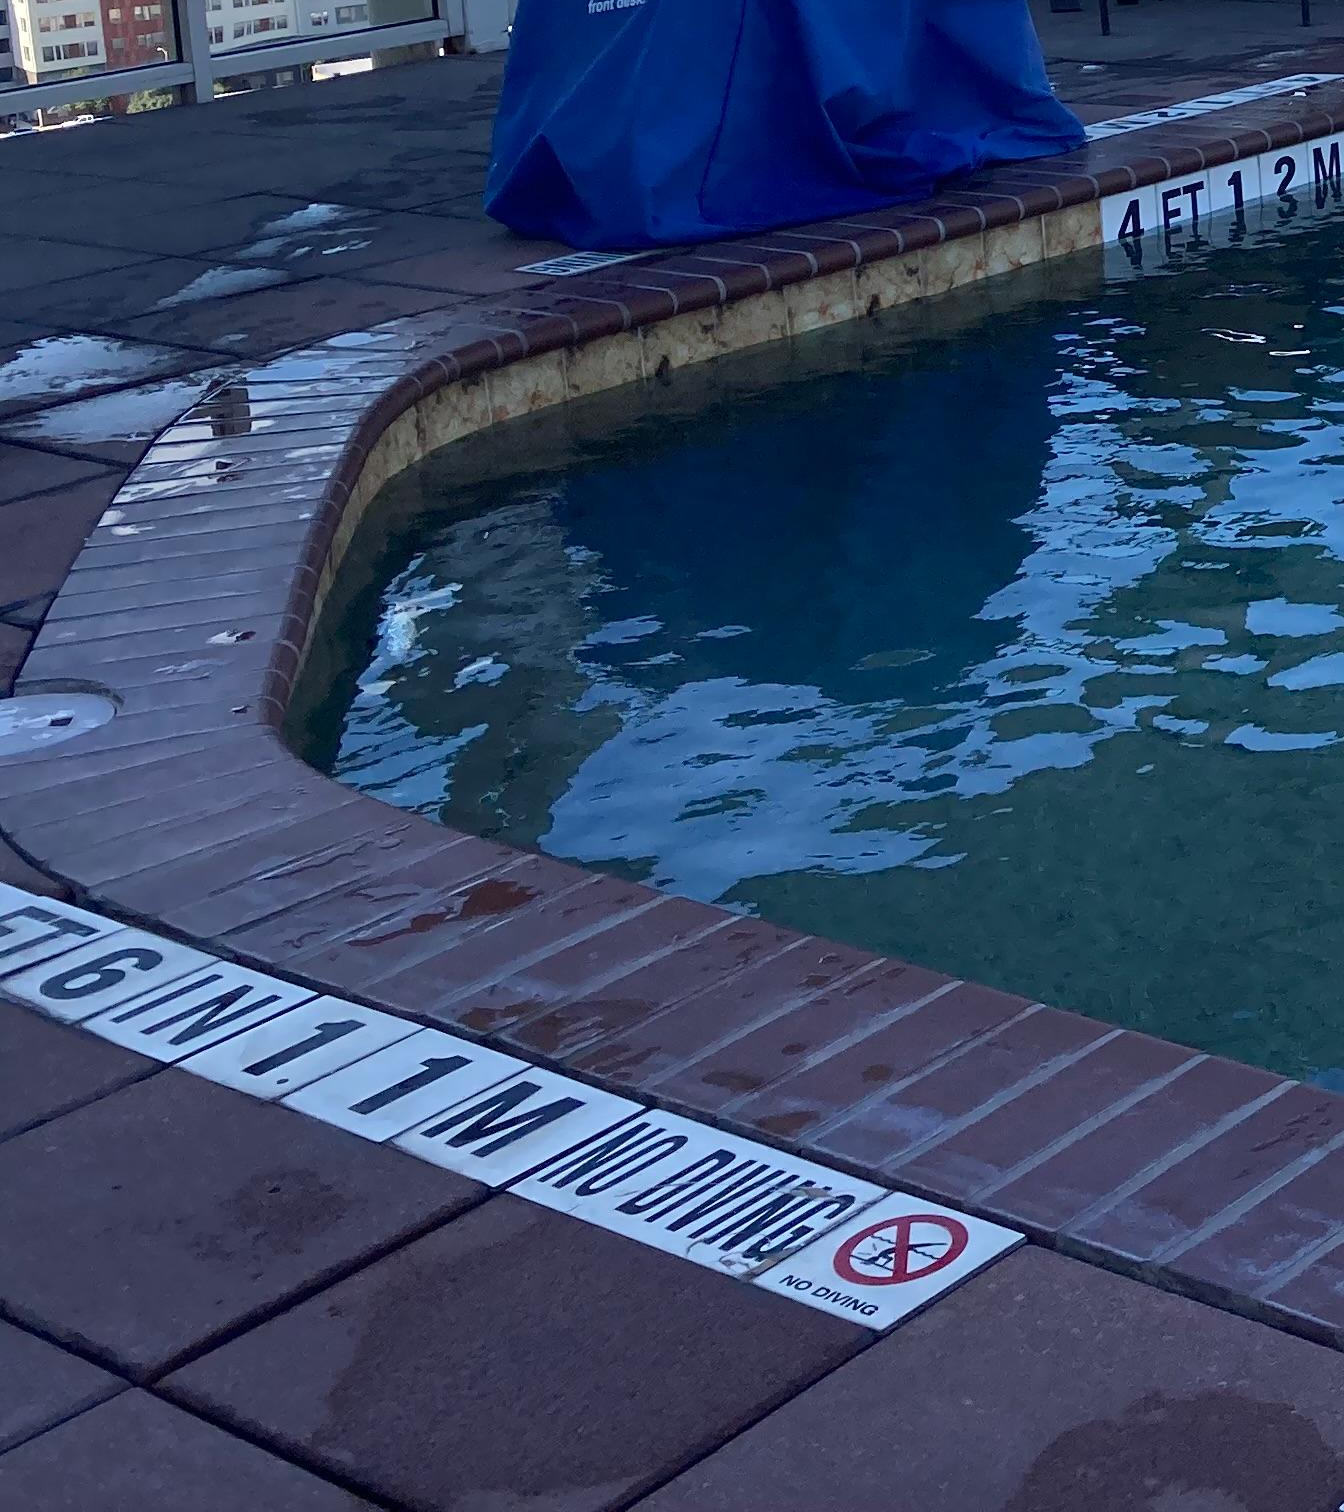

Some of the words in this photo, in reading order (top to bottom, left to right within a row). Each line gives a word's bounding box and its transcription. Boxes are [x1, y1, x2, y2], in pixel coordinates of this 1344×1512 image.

[1117, 199, 1145, 239] 4
[1161, 180, 1205, 235] FT
[1227, 170, 1245, 210] 1
[1274, 155, 1297, 196] 2
[1313, 142, 1342, 187] M
[39, 947, 164, 1000] 6
[109, 973, 283, 1046] IN
[348, 1054, 474, 1116] 1
[420, 1080, 587, 1159] M
[537, 1121, 689, 1197] NO
[614, 1148, 857, 1263] DIVING
[780, 1273, 813, 1293] NO
[811, 1286, 880, 1317] DIVING
